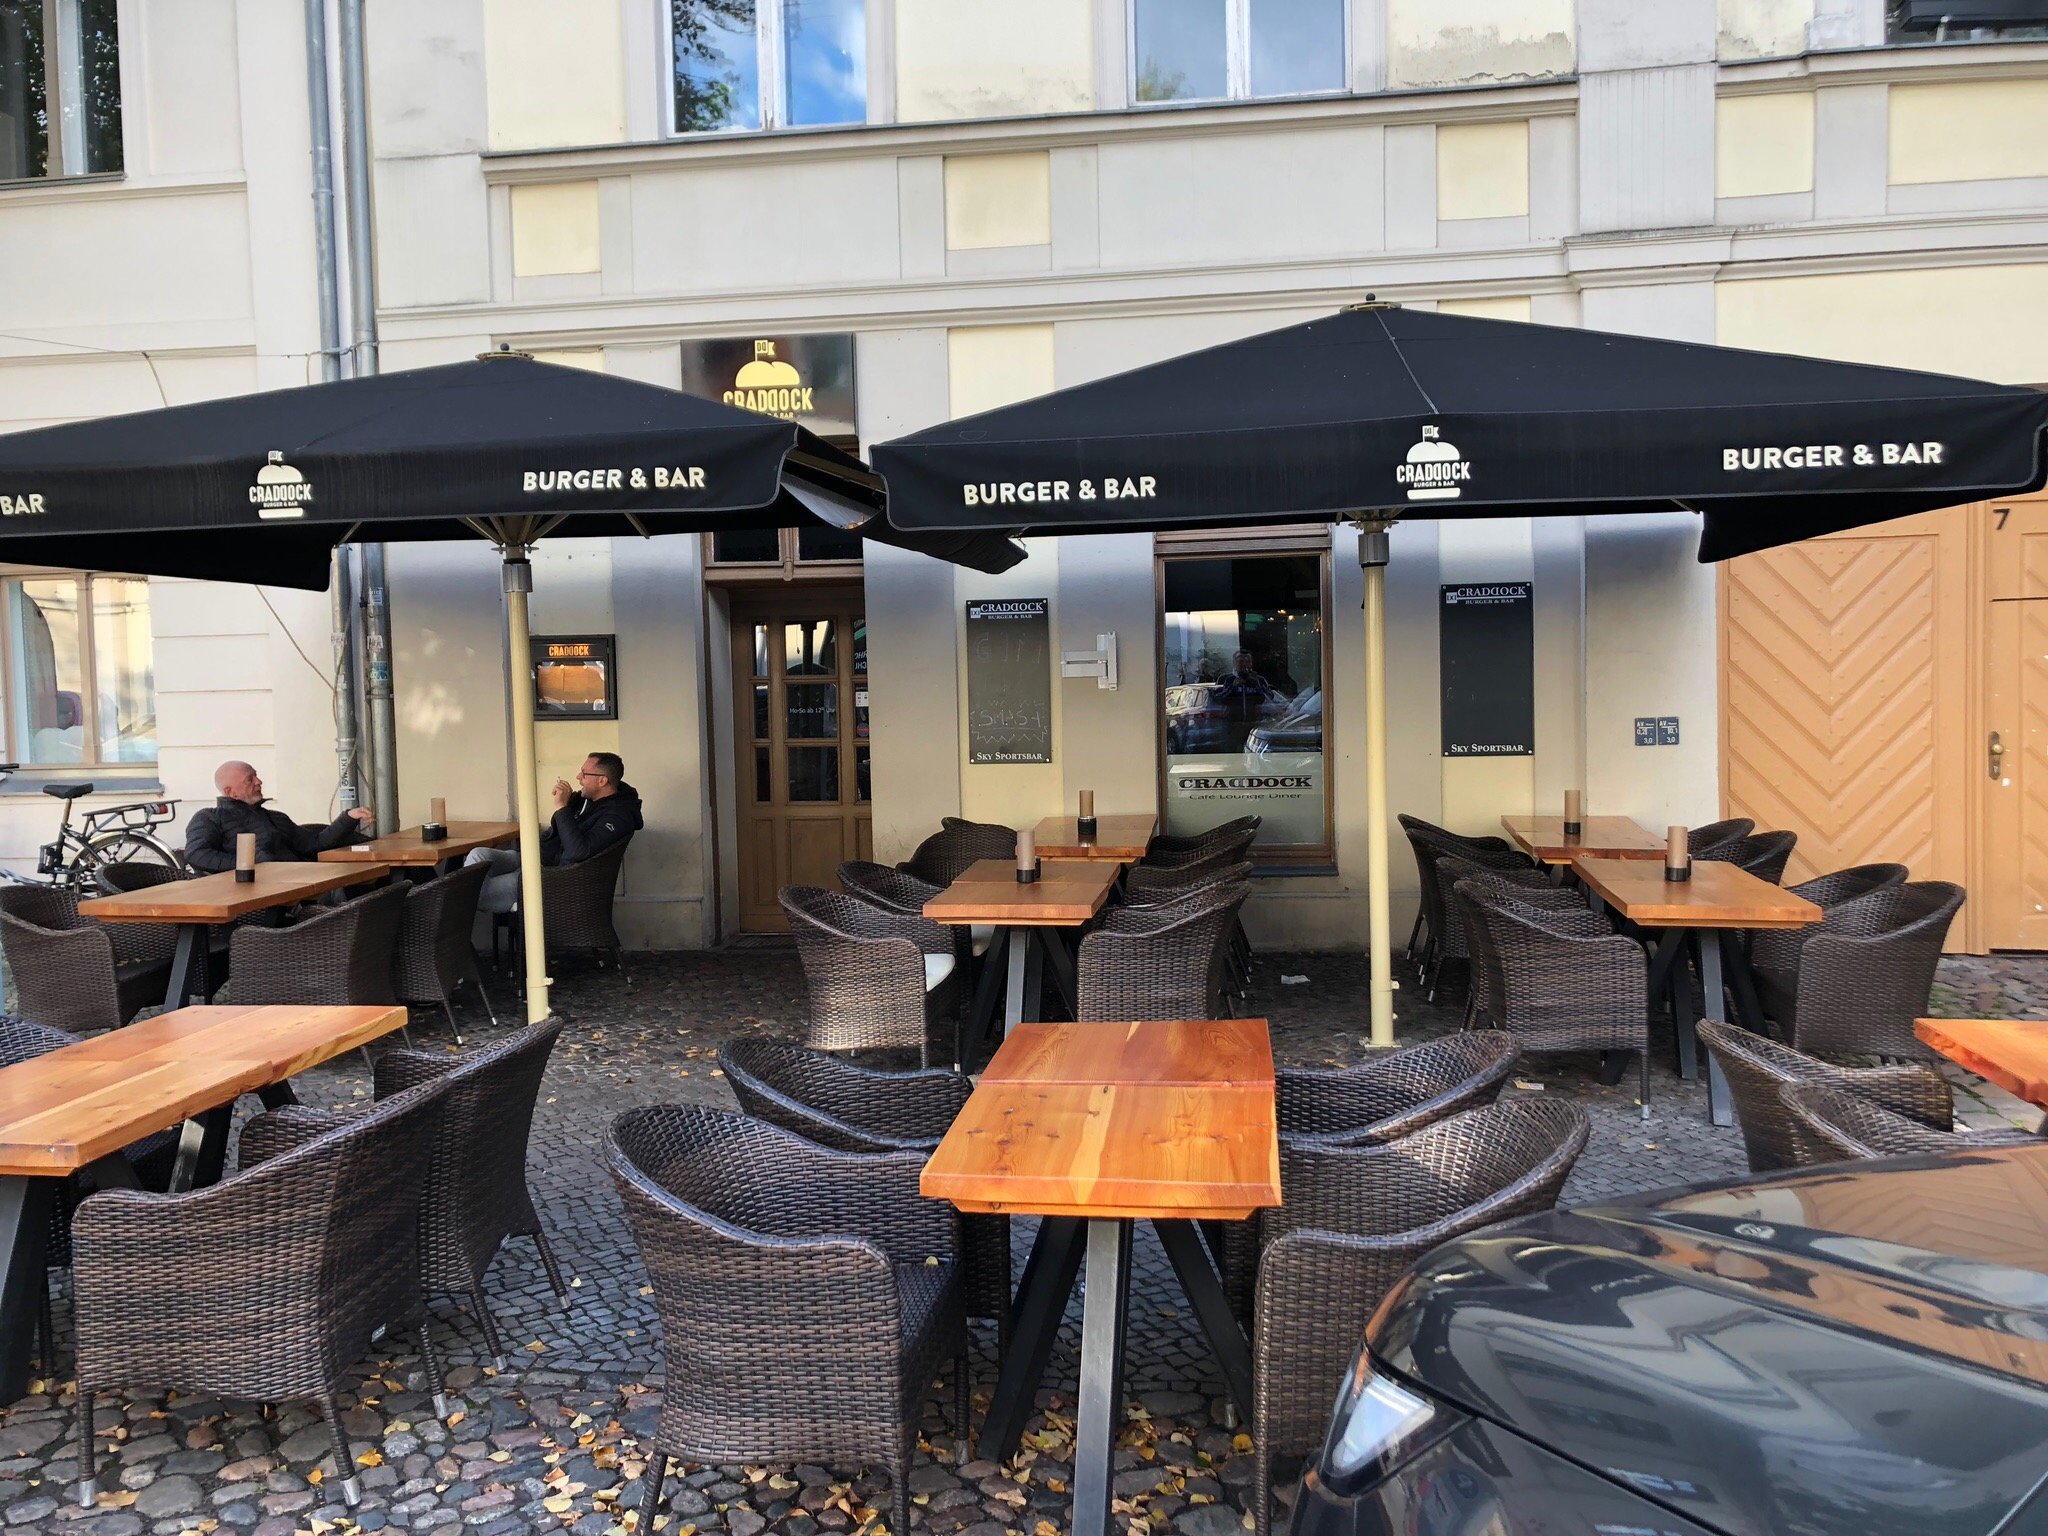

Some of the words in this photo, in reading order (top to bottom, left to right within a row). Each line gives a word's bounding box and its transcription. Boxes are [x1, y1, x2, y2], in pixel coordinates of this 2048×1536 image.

[723, 387, 813, 412] CRADDOCK
[1723, 445, 1844, 471] BURGER
[1853, 444, 1875, 466] &
[1882, 442, 1942, 465] BAR
[523, 469, 622, 491] BURGER
[630, 467, 647, 488] &
[654, 467, 705, 488] BAR
[1396, 461, 1471, 483] CRADDOCK
[248, 484, 312, 503] CRADDOCK
[964, 480, 1070, 505] BURGER
[1078, 479, 1097, 500] &
[1104, 476, 1156, 499] BAR
[0, 494, 45, 515] BAR
[1992, 508, 2010, 530] 7
[1457, 586, 1526, 597] CRADDOCK
[980, 602, 1043, 612] CRADDOCK
[548, 645, 589, 657] CRADDOCK
[1179, 777, 1312, 788] CRADDOCK
